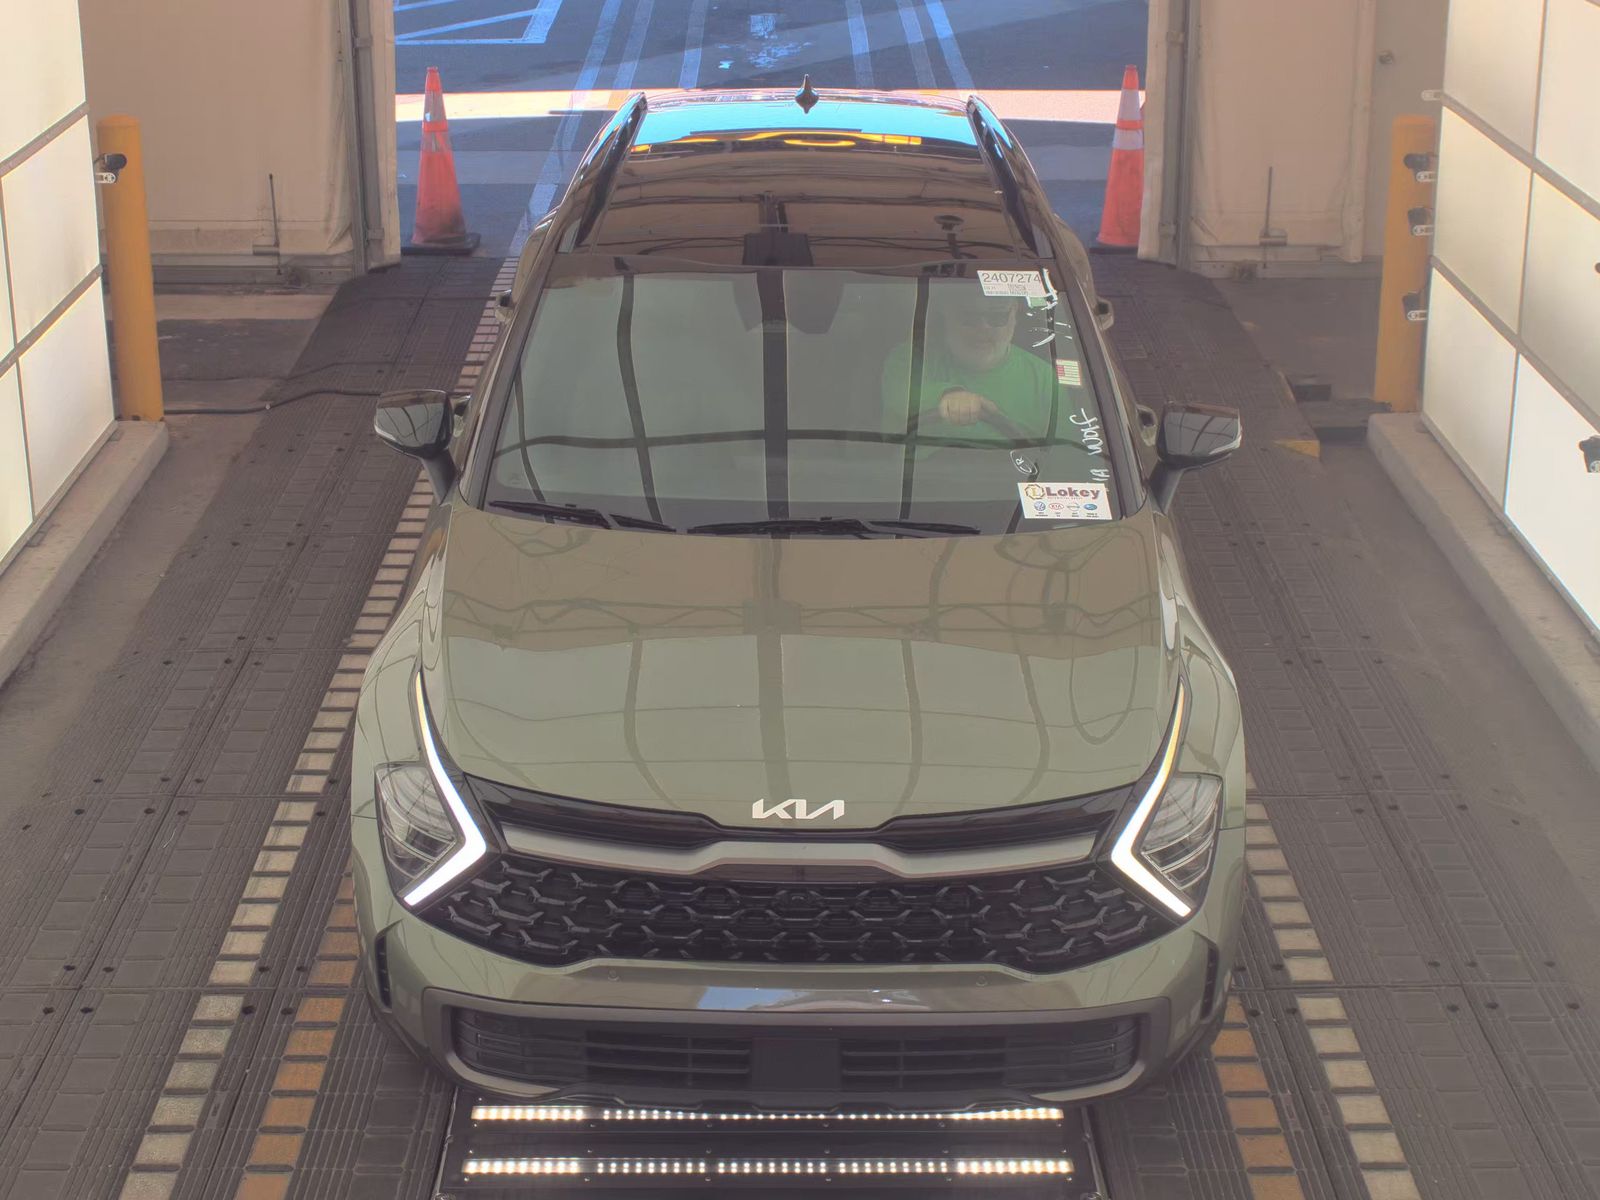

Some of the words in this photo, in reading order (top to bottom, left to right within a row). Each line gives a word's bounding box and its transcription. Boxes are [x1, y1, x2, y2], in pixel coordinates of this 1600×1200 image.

[981, 272, 1041, 284] 2407274
[1045, 487, 1100, 499] Lokey
[752, 798, 845, 820] KIA
